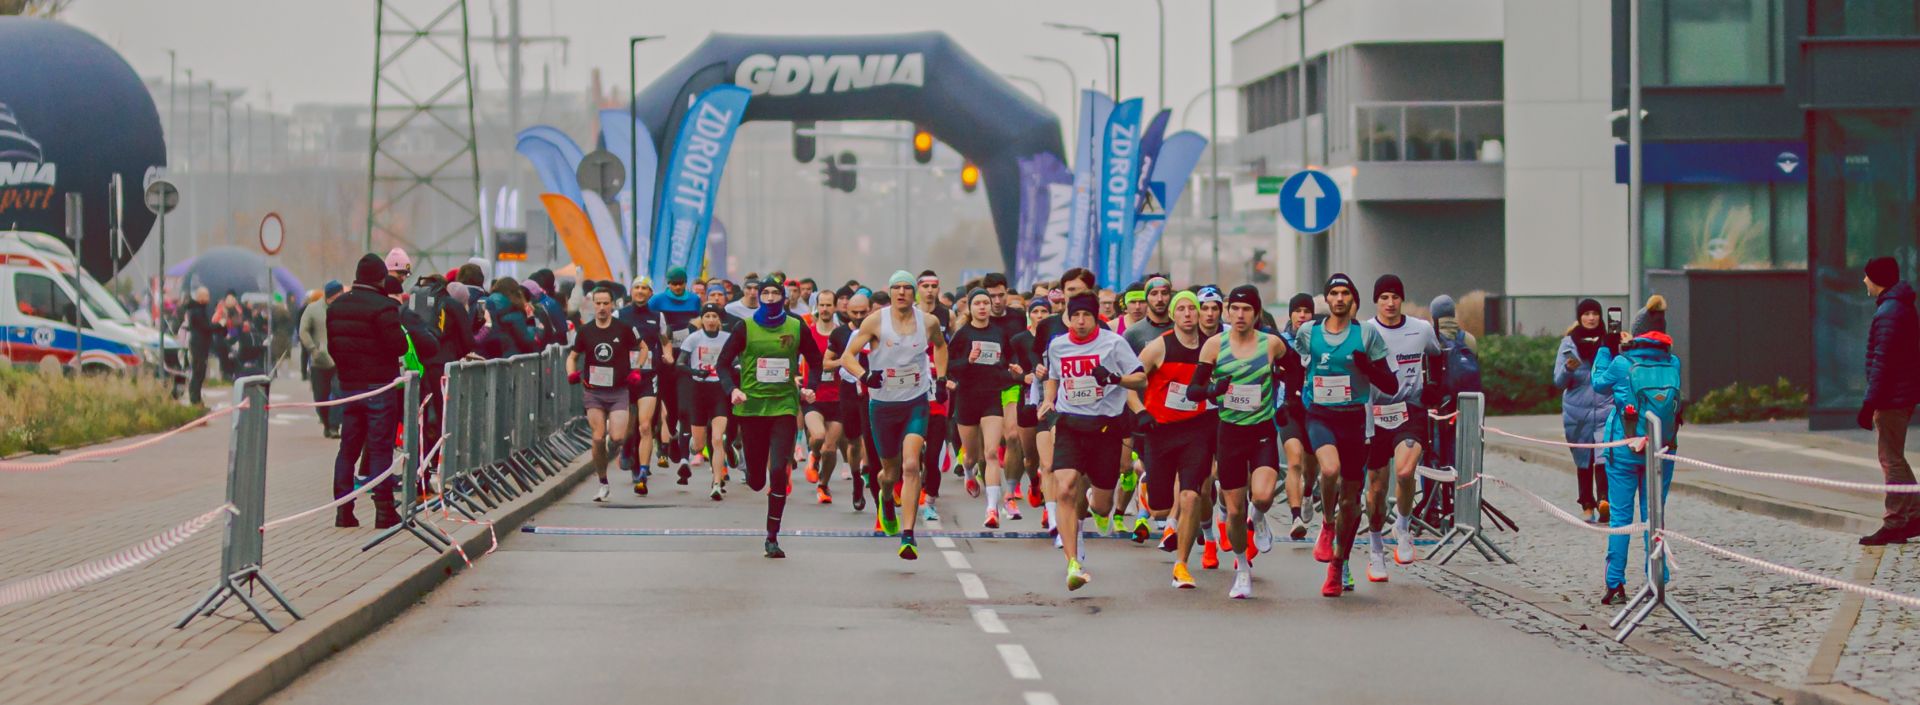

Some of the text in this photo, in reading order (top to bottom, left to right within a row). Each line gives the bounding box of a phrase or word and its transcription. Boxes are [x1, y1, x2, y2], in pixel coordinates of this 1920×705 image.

[735, 53, 924, 97] GDYNIA
[674, 101, 733, 215] ZDROFIT
[1107, 122, 1136, 235] ZDROFIT
[1072, 390, 1092, 399] 3462
[1230, 395, 1250, 405] 3855
